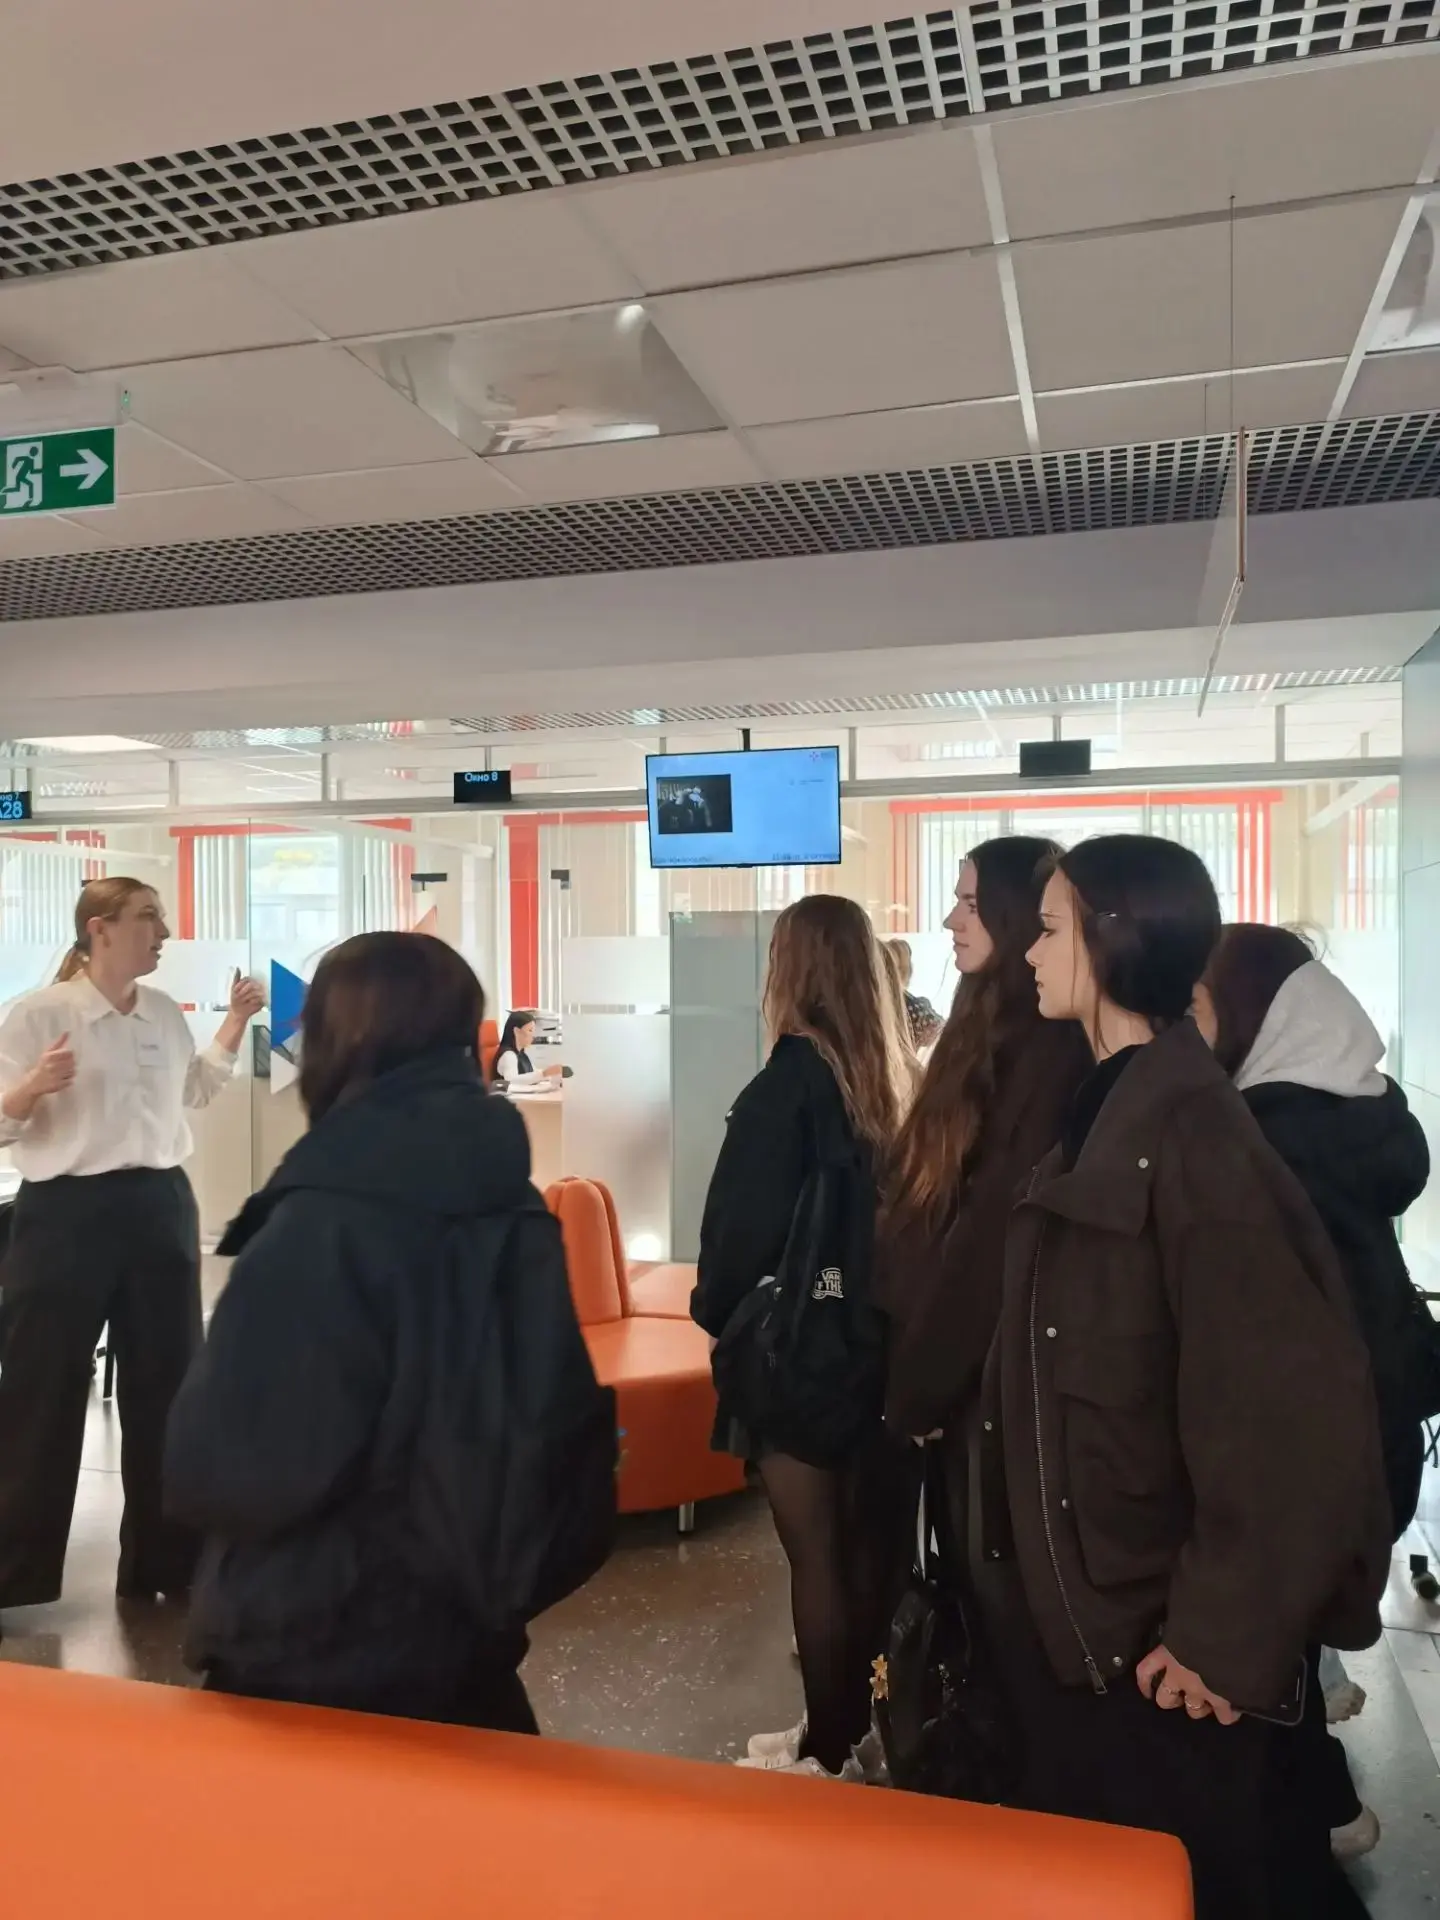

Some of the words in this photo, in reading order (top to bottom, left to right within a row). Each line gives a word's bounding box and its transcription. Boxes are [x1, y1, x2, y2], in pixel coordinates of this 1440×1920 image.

[465, 772, 489, 782] Окно
[491, 771, 498, 781] 8
[0, 800, 22, 818] 28
[822, 1271, 840, 1280] VAN
